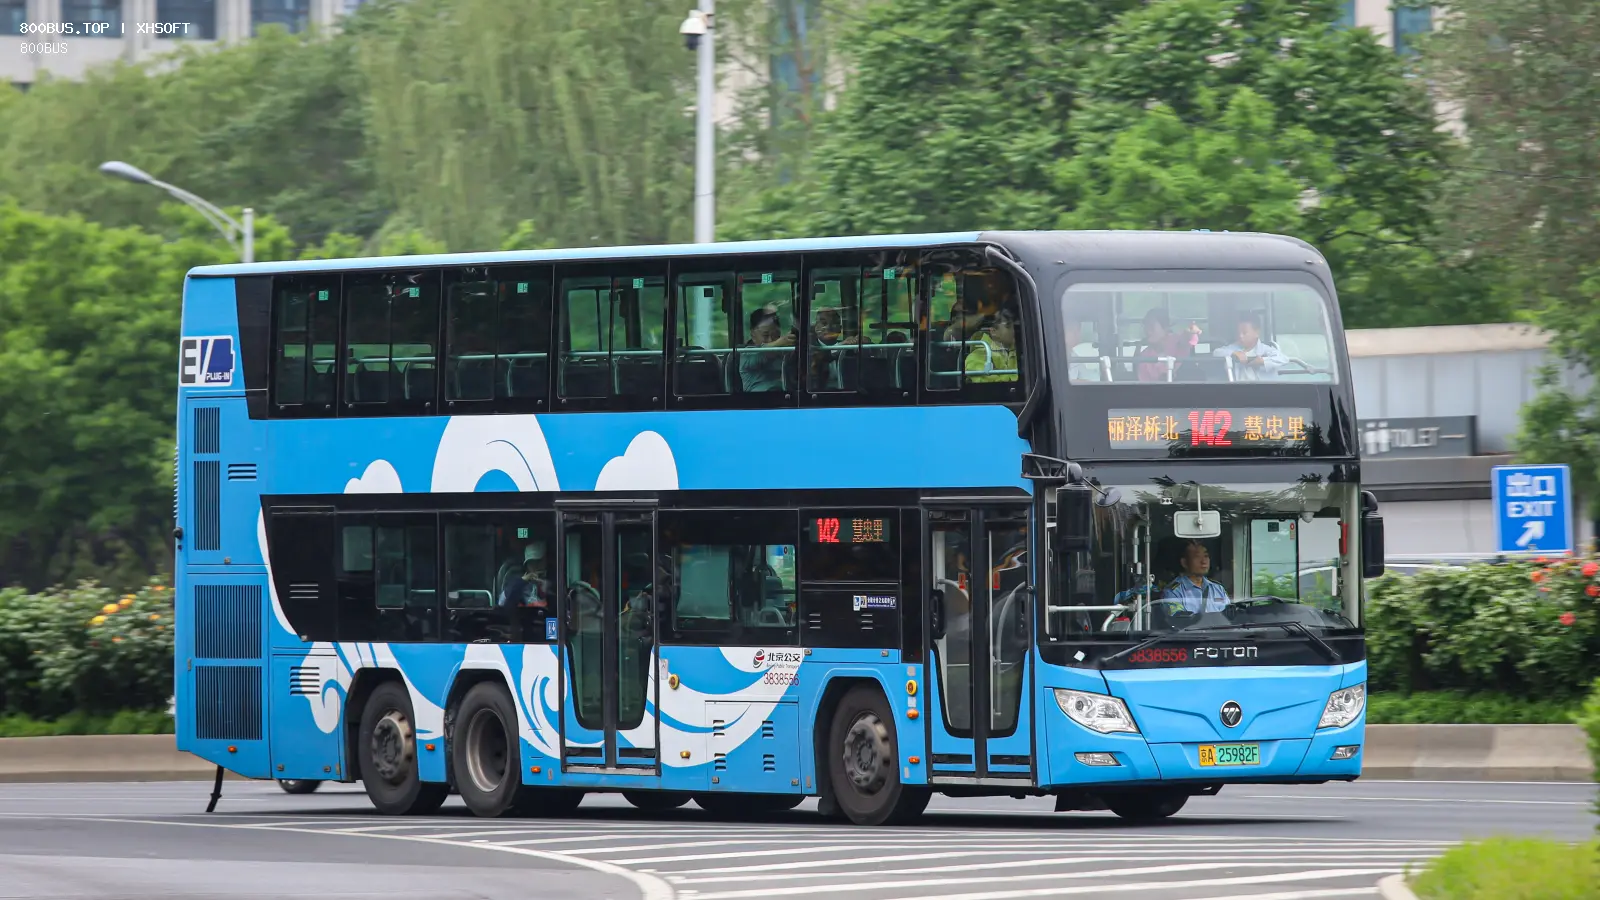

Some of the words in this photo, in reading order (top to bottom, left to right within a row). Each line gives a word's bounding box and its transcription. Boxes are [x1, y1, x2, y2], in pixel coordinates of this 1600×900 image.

[206, 372, 230, 380] PLUG-IN
[1108, 415, 1179, 441] 丽泽桥北
[1187, 410, 1232, 446] 142
[1244, 415, 1306, 441] 慧忠里
[1506, 473, 1556, 497] 出口
[1506, 501, 1556, 518] EXIT
[816, 518, 840, 543] 142
[852, 518, 883, 543] 慧忠里
[767, 653, 801, 662] 北京公交
[1129, 648, 1188, 663] 3838556
[1193, 646, 1258, 659] FOTON
[764, 672, 800, 686] 3838556
[1200, 748, 1214, 763] 京A
[1218, 746, 1258, 762] 25982F
